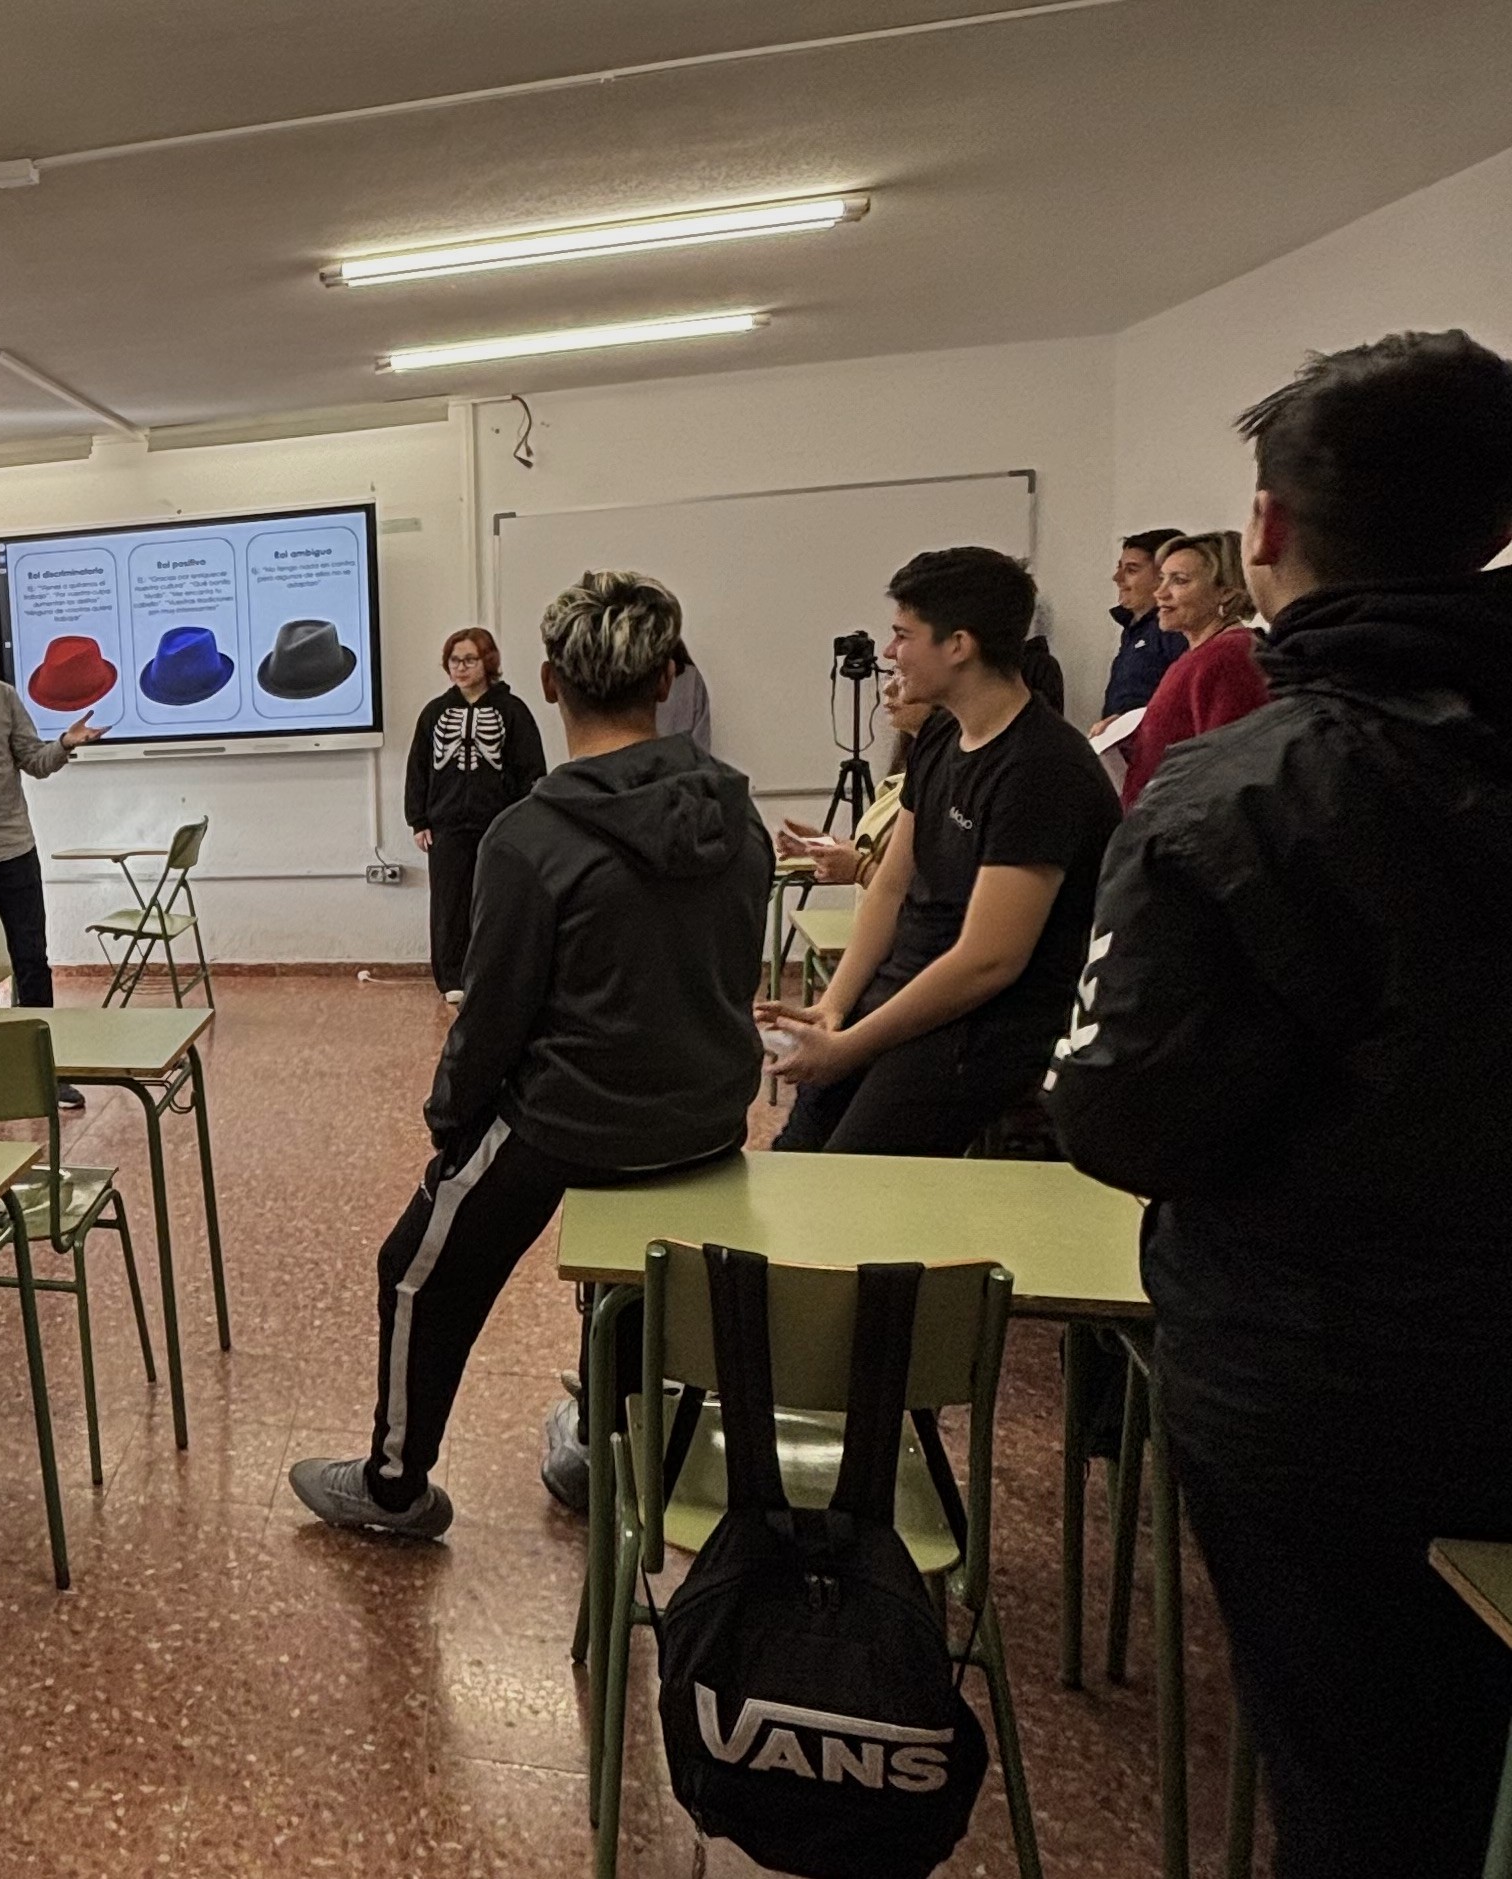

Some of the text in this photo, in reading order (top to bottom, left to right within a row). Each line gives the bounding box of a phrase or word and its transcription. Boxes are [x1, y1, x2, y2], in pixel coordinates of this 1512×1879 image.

[274, 548, 332, 559] Rol ambiguo
[157, 559, 206, 570] Rol positivo
[28, 567, 104, 580] Rol discriminatorio
[693, 1681, 955, 1793] VANS
